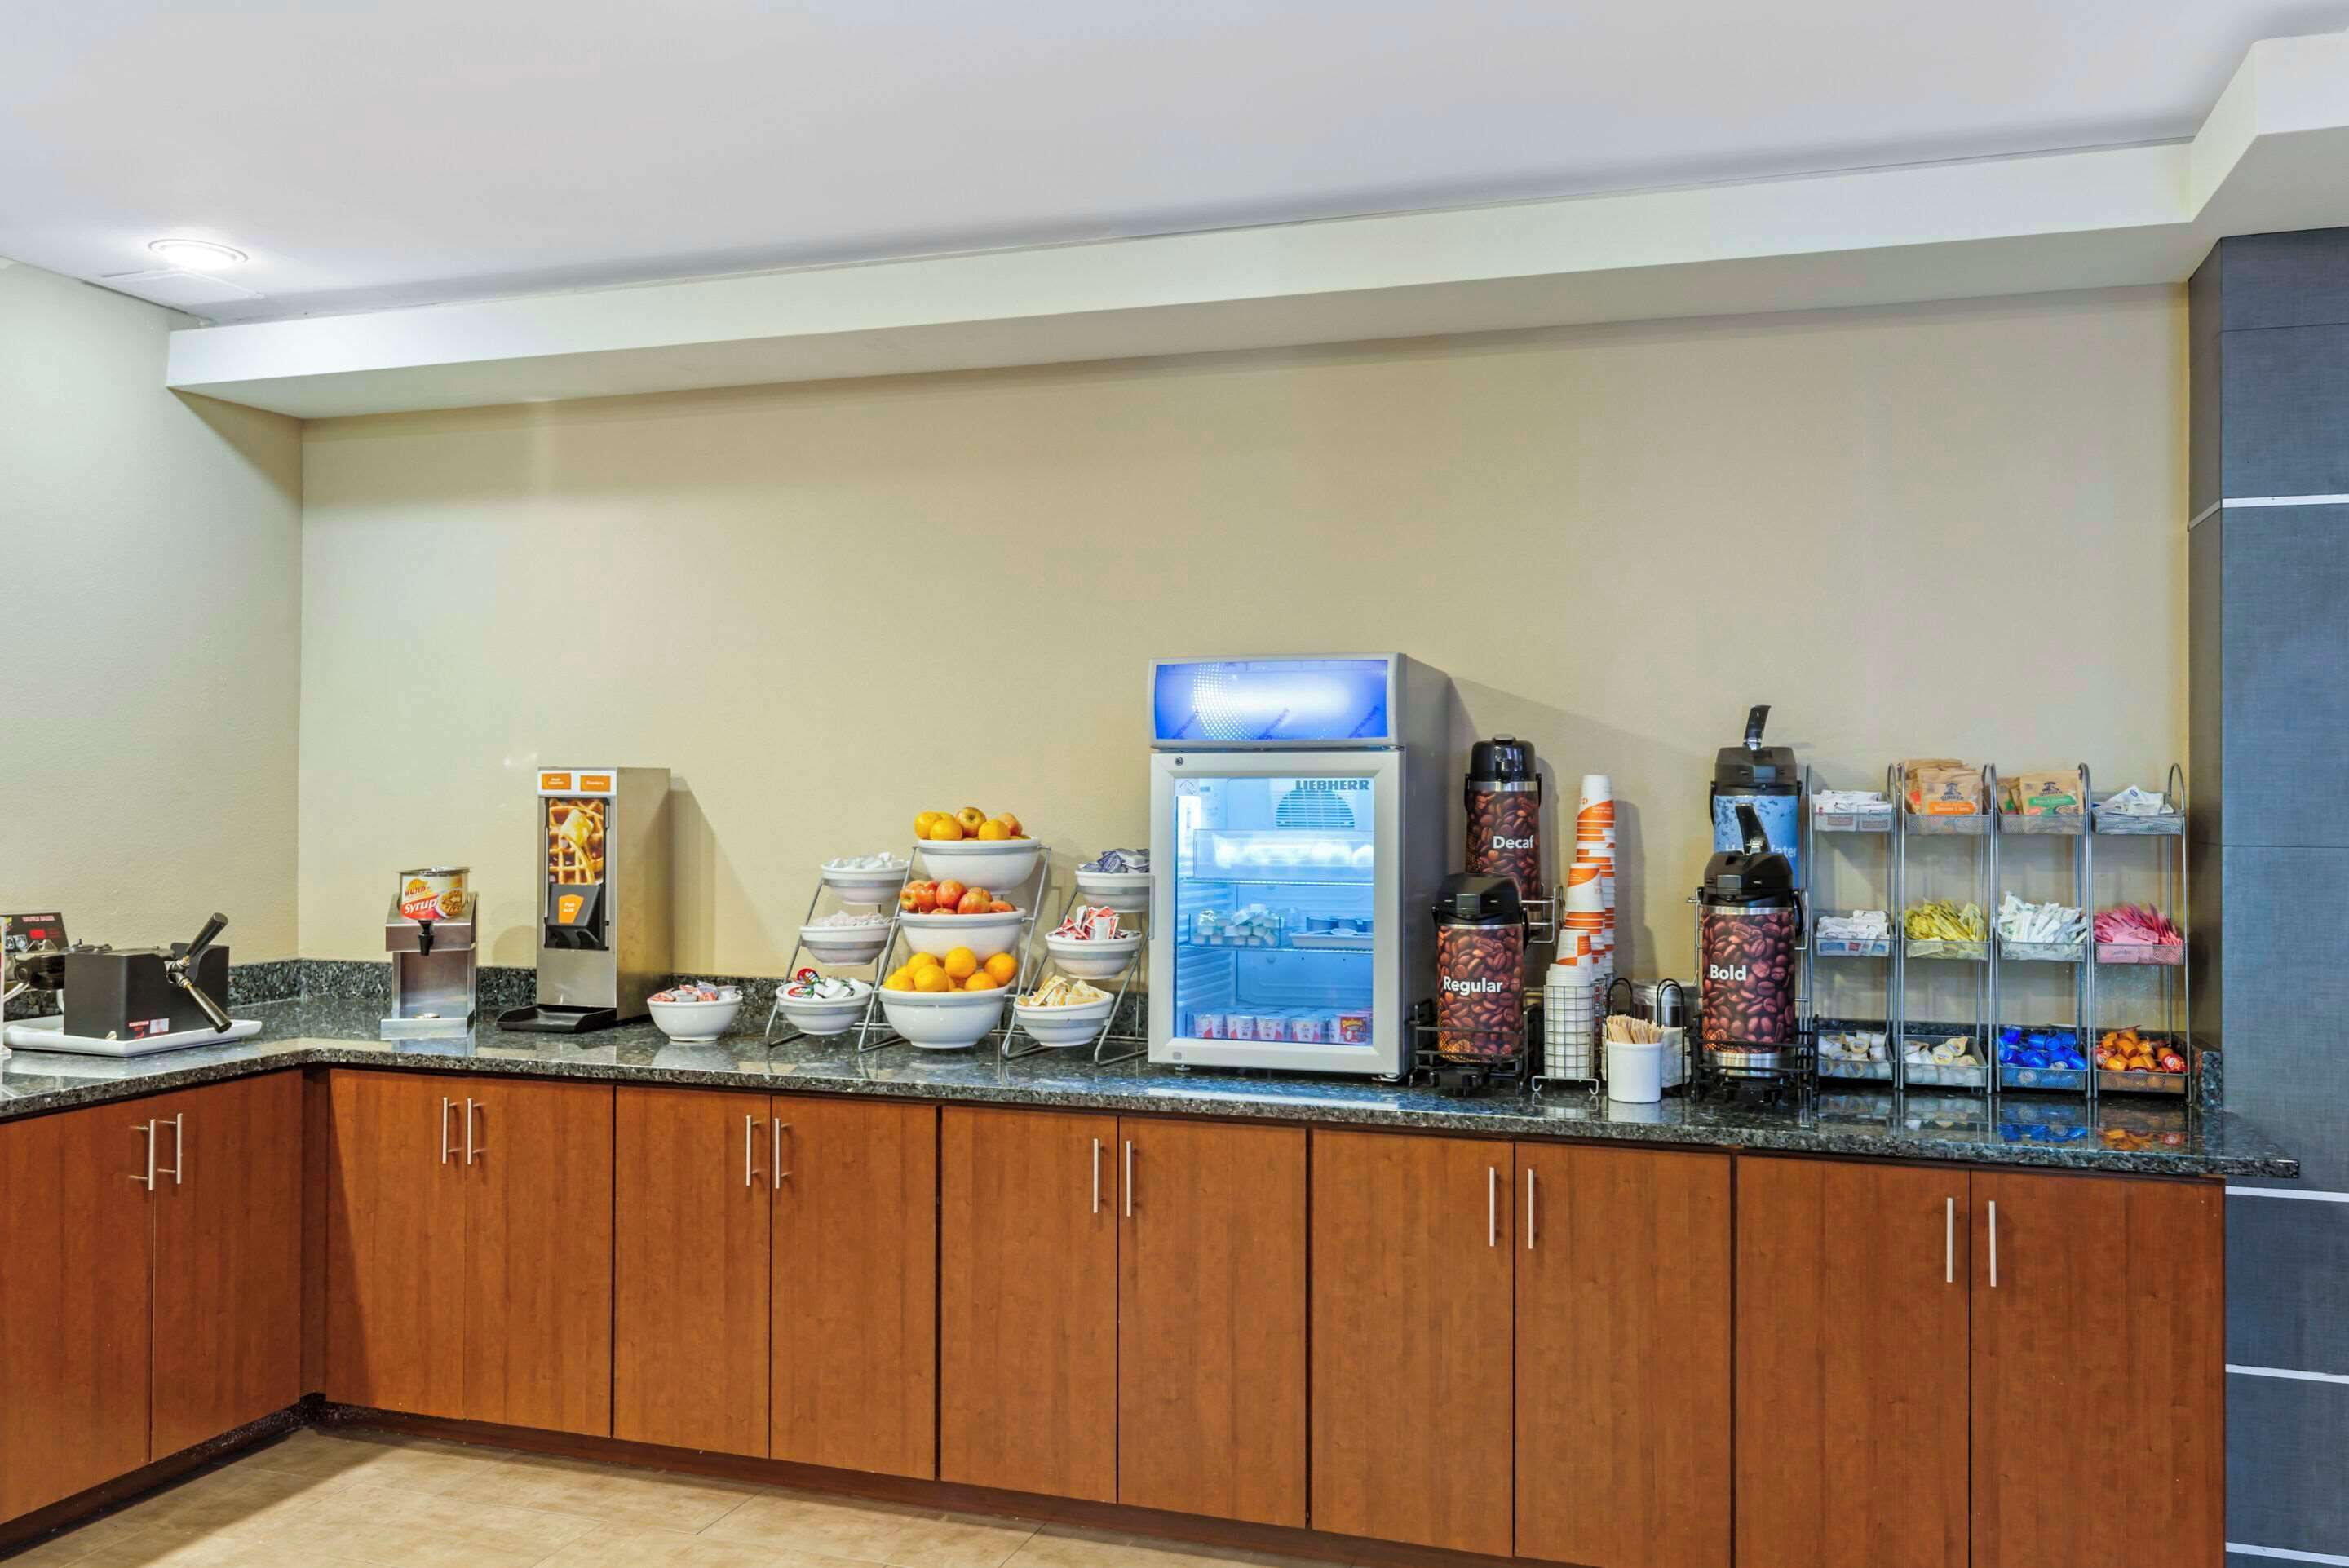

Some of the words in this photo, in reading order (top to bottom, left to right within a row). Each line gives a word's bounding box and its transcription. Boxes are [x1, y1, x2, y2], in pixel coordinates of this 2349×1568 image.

[1295, 780, 1370, 790] LIEBHERR
[1493, 834, 1534, 849] Decaf
[1710, 964, 1747, 981] Bold
[1443, 975, 1503, 996] Regular
